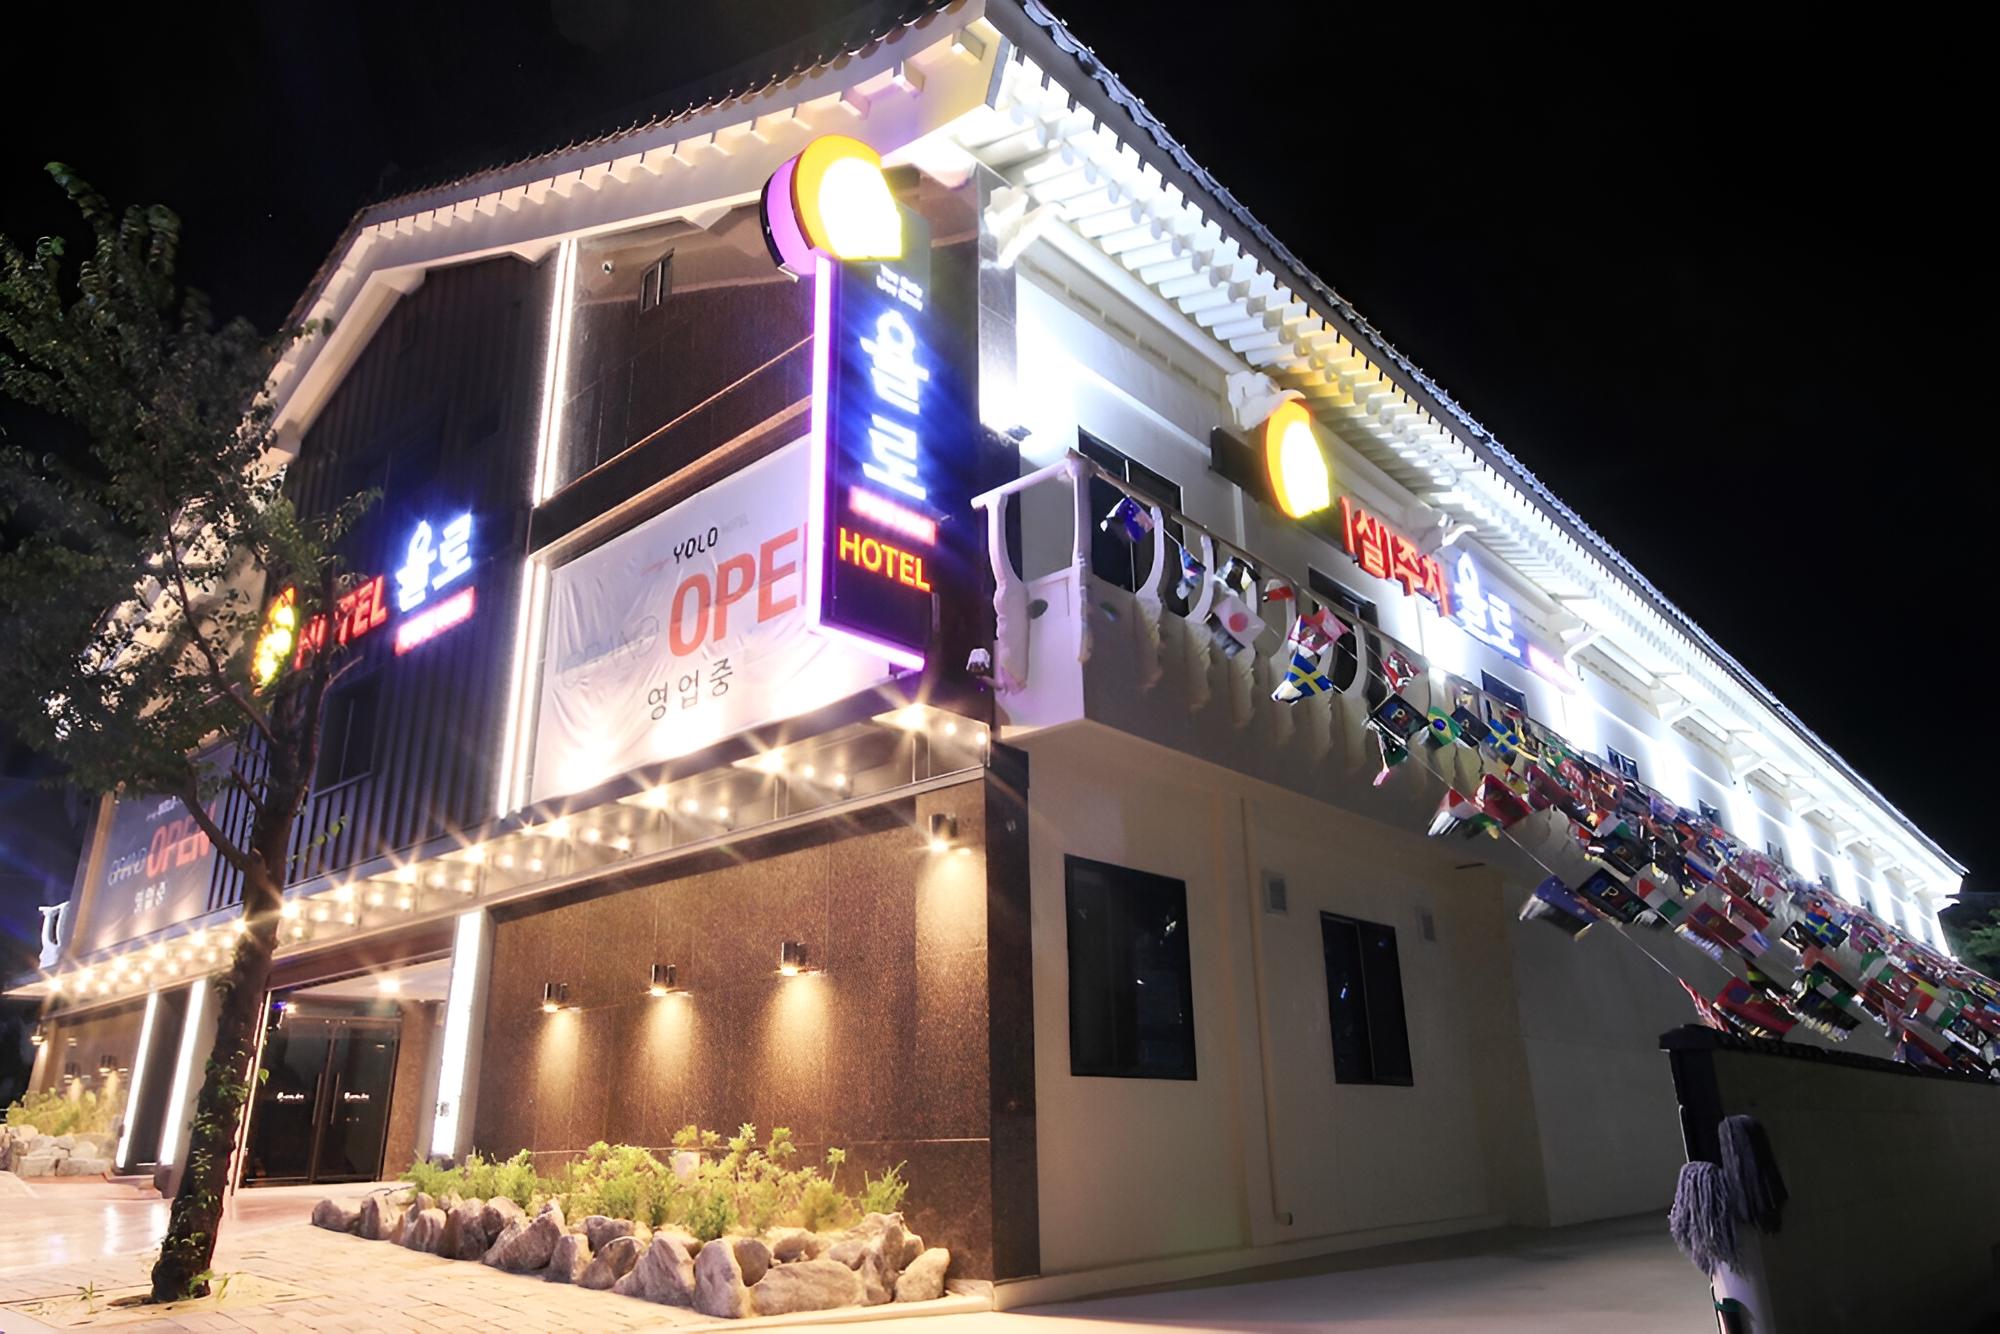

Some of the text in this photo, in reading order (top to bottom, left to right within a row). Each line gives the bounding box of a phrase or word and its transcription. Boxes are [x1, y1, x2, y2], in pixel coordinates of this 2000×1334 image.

[673, 526, 718, 564] YOLO
[839, 528, 931, 592] HOTEL
[669, 522, 808, 657] OPE
[647, 657, 733, 721] 영업중
